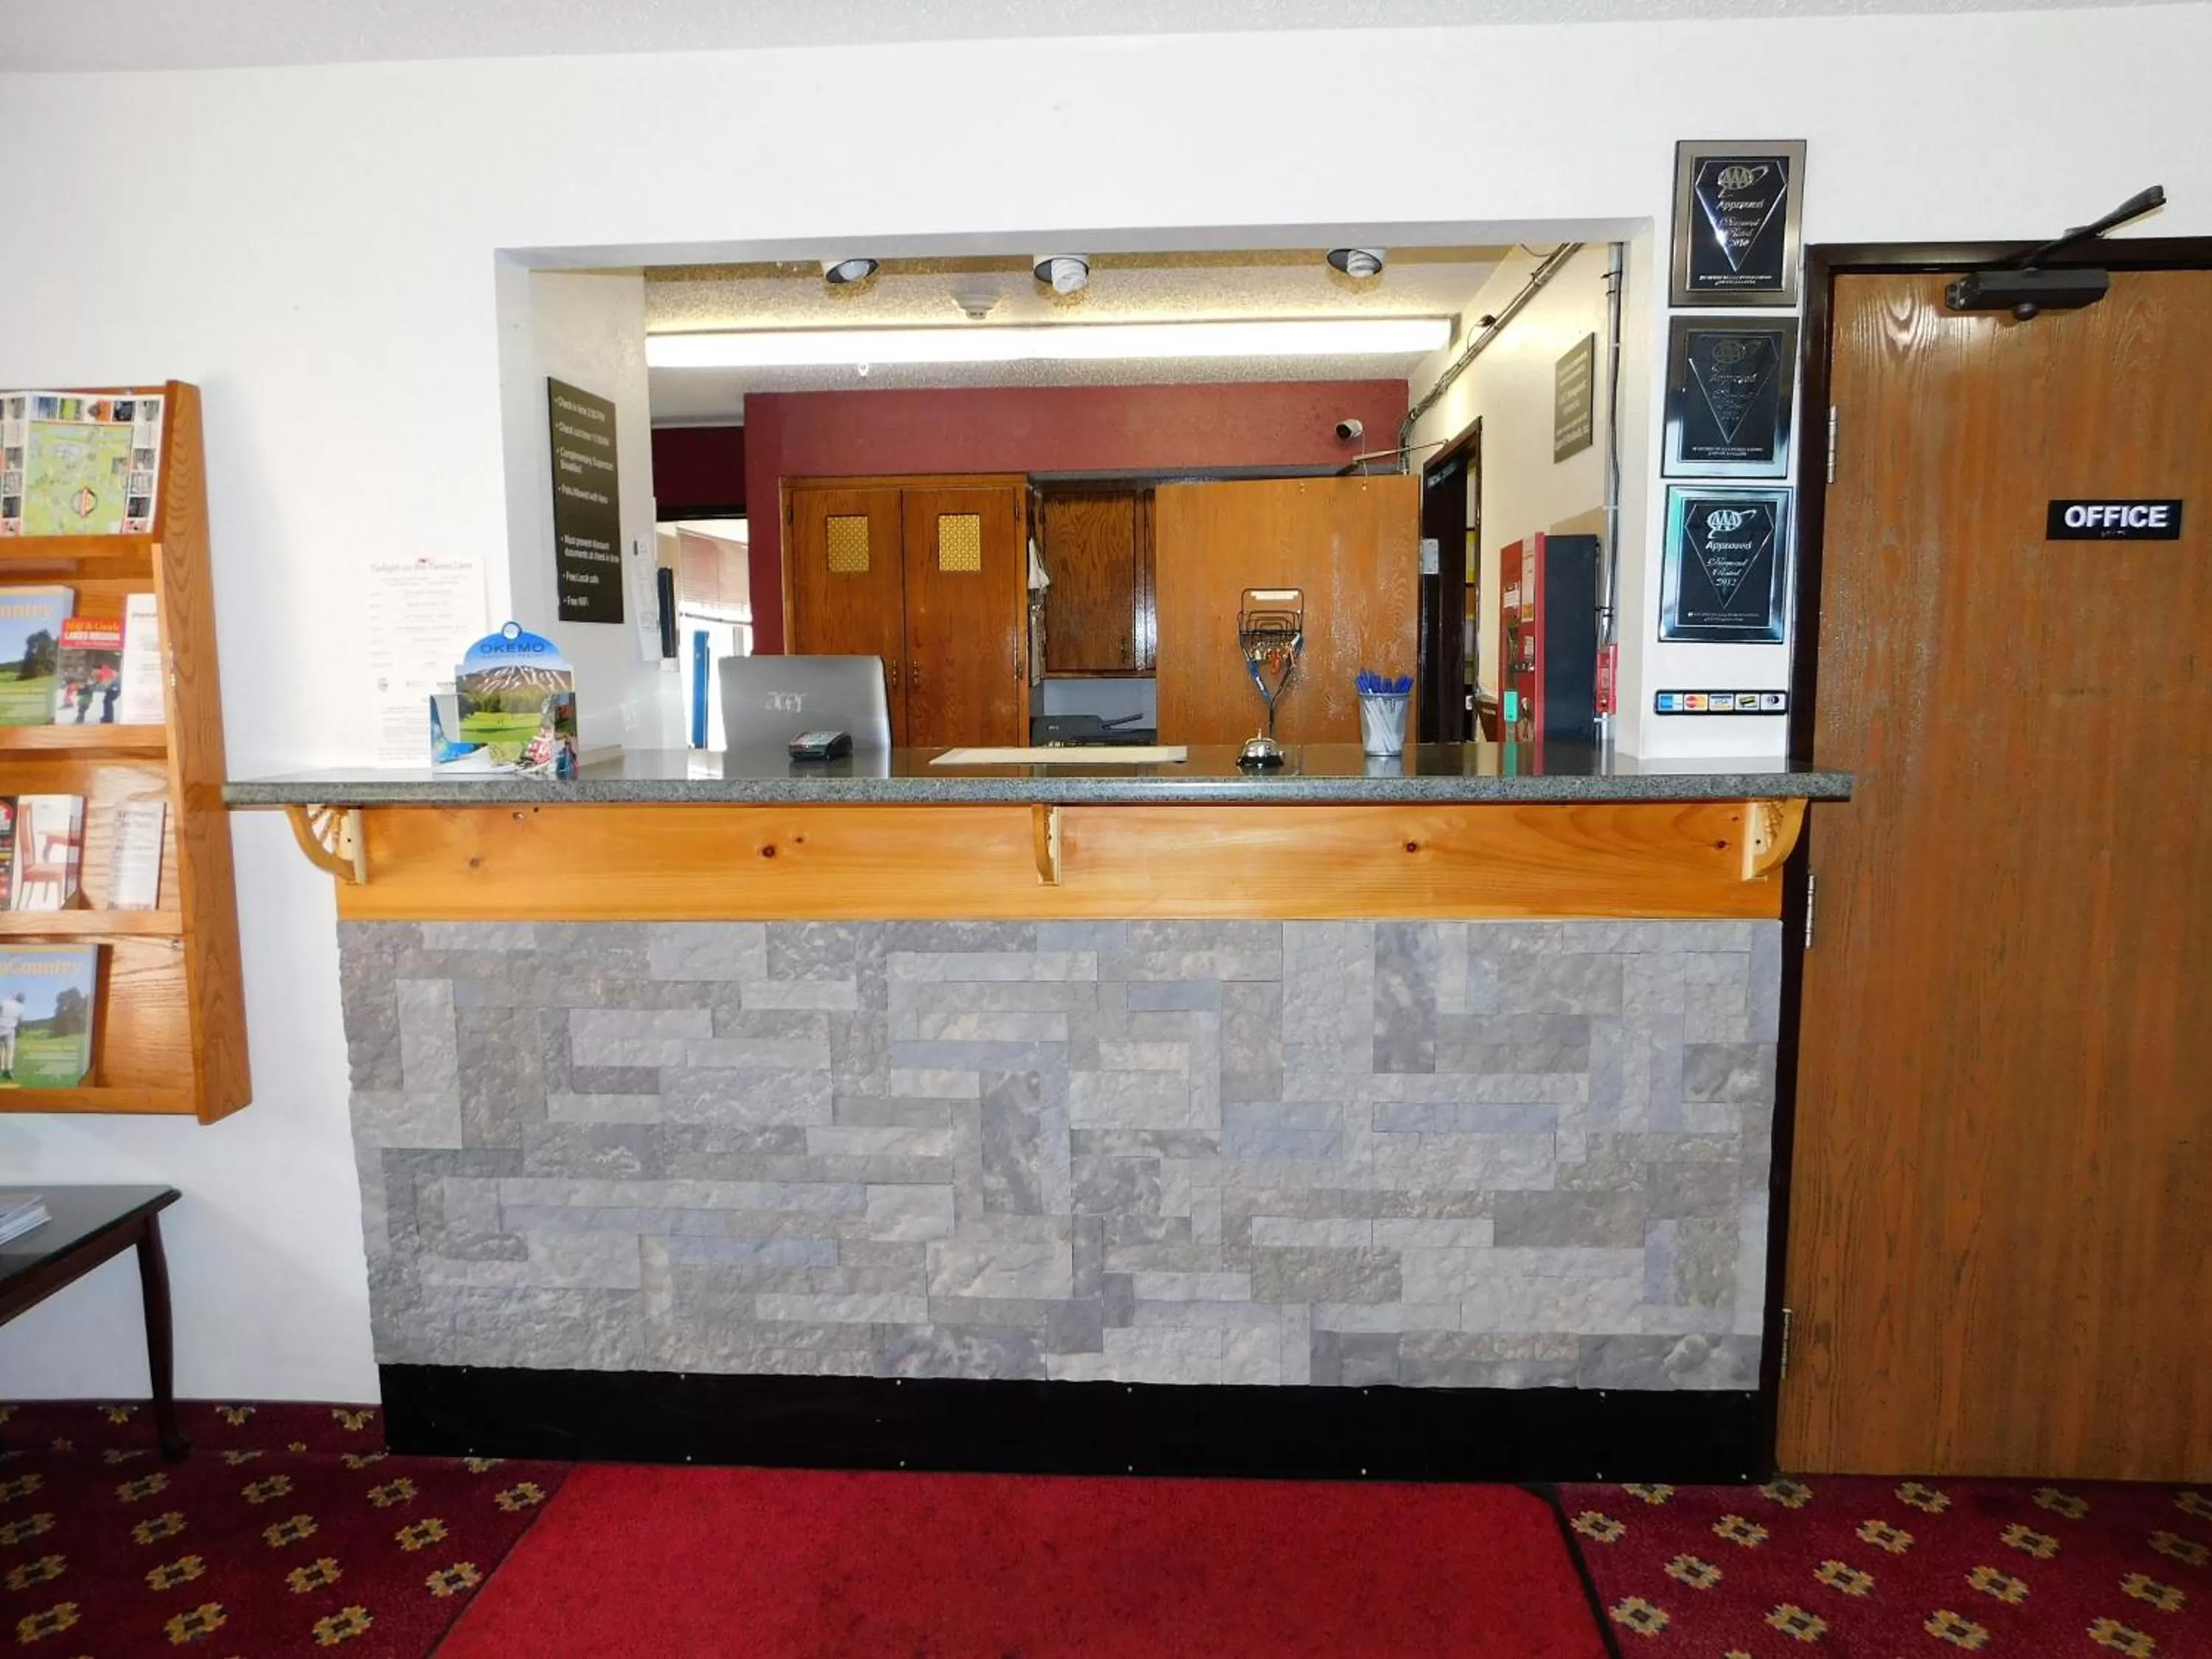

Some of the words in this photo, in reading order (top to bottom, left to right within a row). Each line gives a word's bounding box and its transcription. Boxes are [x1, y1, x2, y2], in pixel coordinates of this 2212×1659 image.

[1719, 167, 1752, 189] AAA
[1717, 200, 1764, 211] Approved
[1707, 510, 1742, 531] AAA
[2065, 505, 2169, 527] OFFICE
[1705, 541, 1753, 552] Approved
[480, 643, 545, 654] OKEMO
[766, 691, 807, 712] acer
